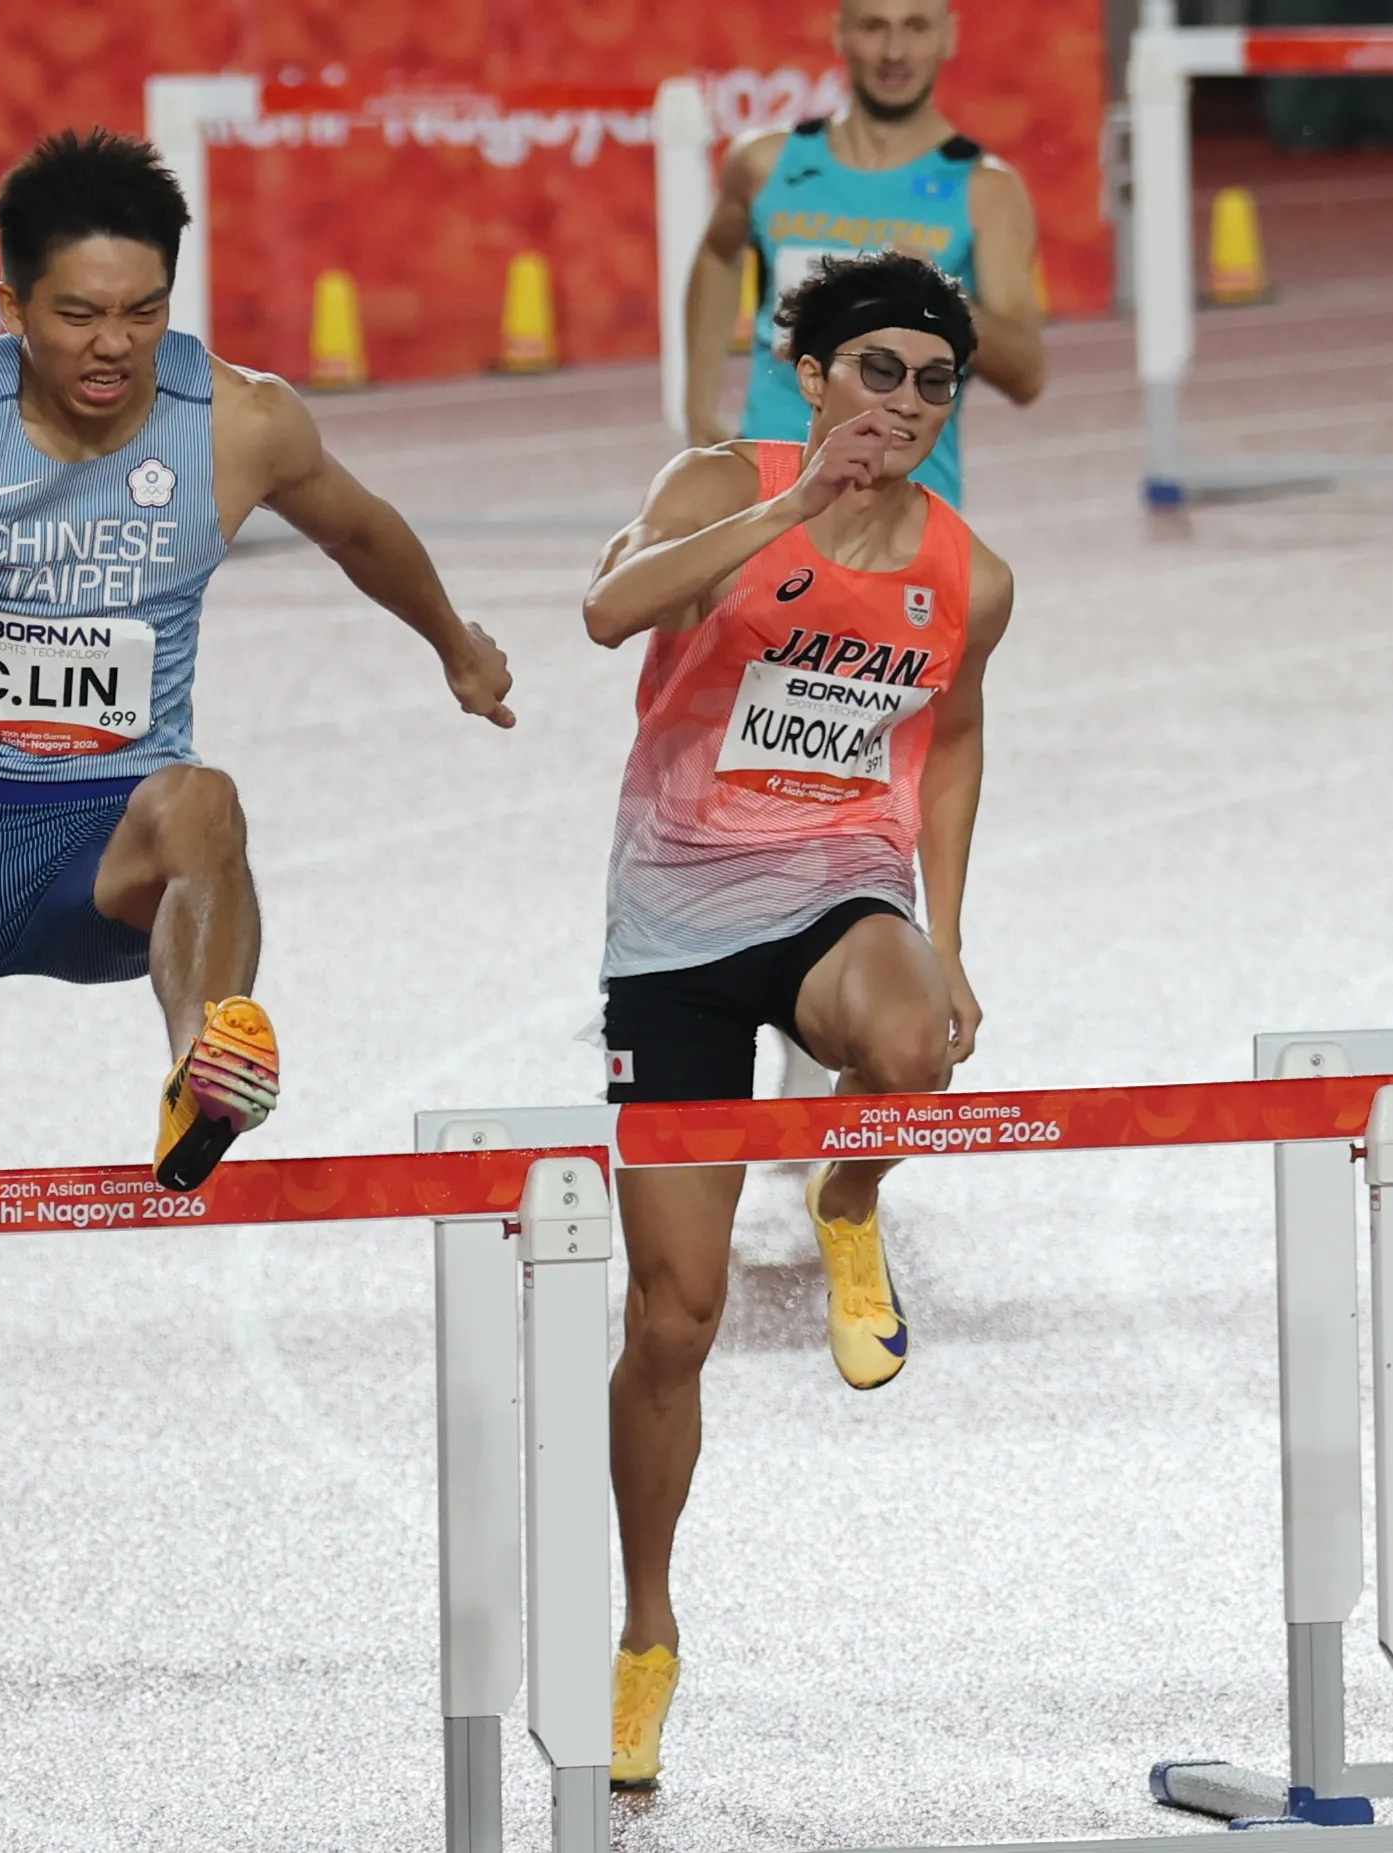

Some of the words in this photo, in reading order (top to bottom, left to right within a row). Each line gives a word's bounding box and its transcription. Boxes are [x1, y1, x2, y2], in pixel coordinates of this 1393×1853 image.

[6, 565, 142, 607] TAIPEI
[32, 647, 110, 660] TECHNOLOGY
[762, 627, 932, 686] JAPAN
[786, 678, 902, 712] BORNAN
[99, 711, 137, 727] 699
[784, 698, 825, 713] SPORTS
[830, 704, 883, 722] TECHNOLO
[73, 740, 99, 749] 2026
[859, 1108, 901, 1124] 20th
[906, 1106, 954, 1122] Asian
[958, 1105, 1021, 1120] Games
[821, 1125, 992, 1152] Aichi-Nagoya
[998, 1120, 1061, 1144] 2026
[0, 1181, 41, 1199] 20th
[46, 1180, 96, 1197] Asian
[100, 1179, 166, 1195] Games
[142, 1196, 207, 1220] 2026
